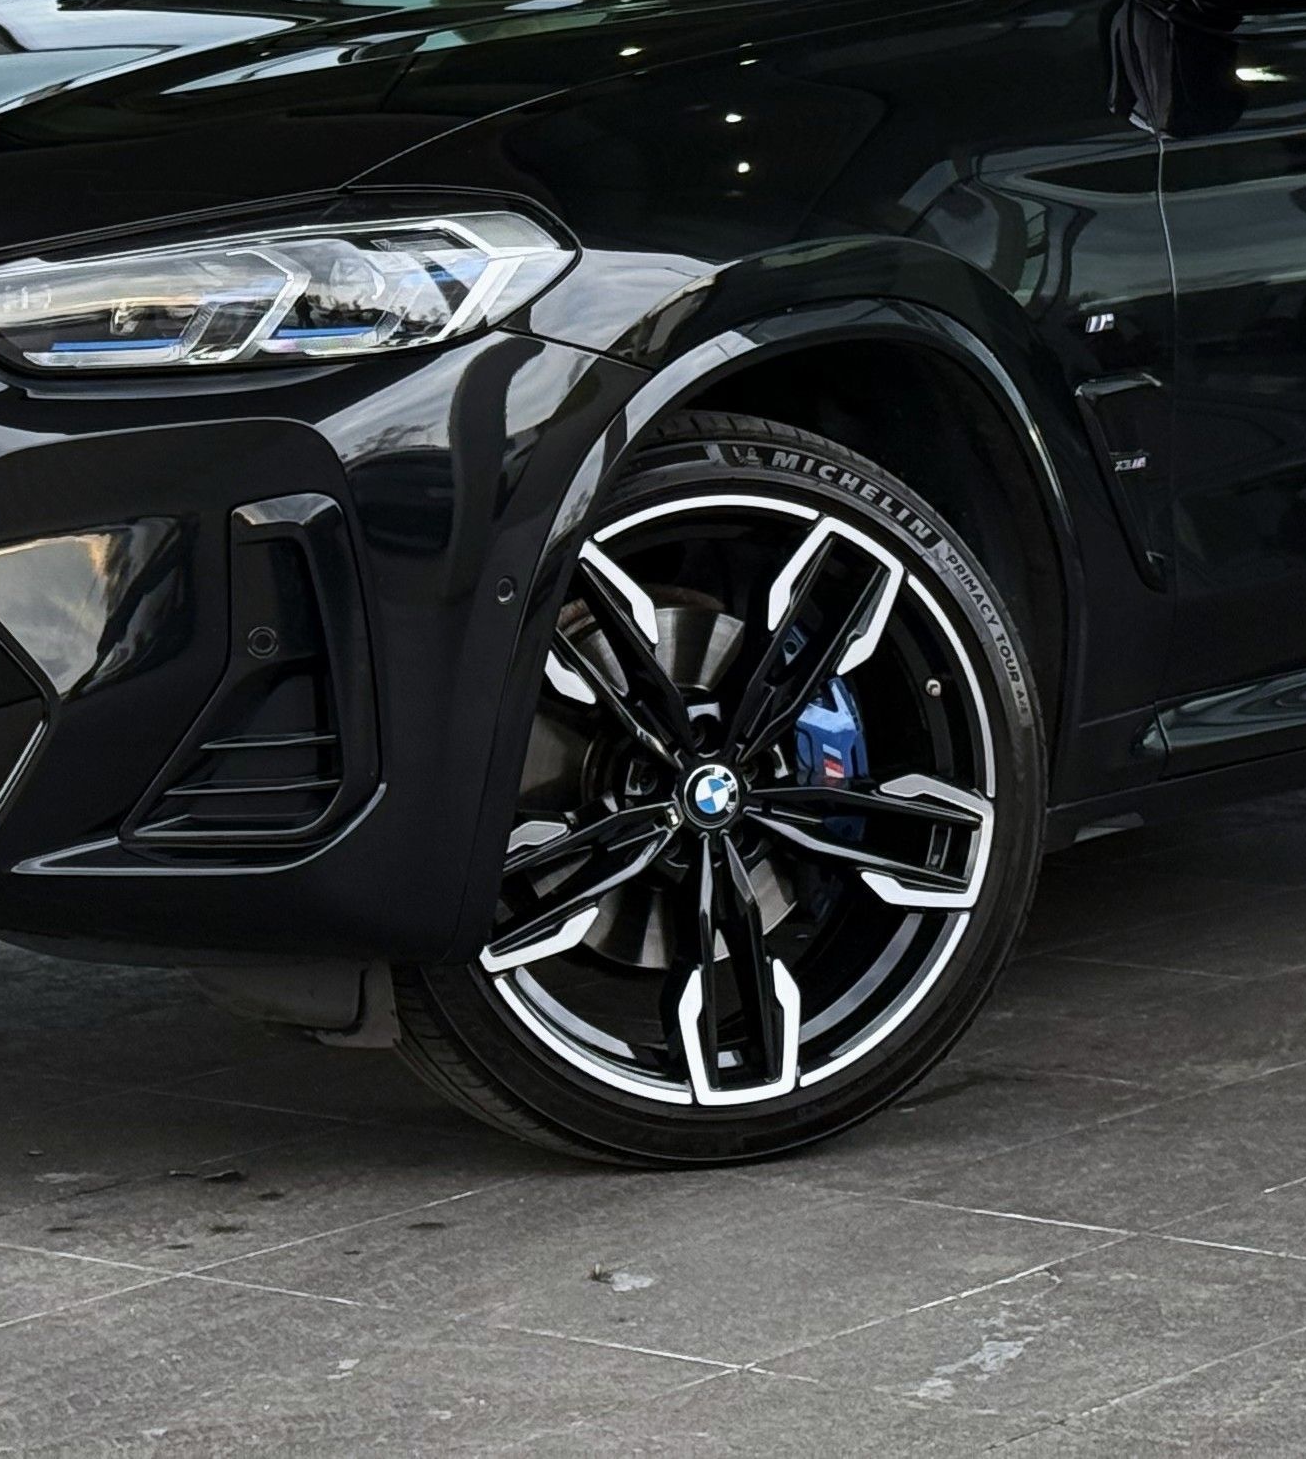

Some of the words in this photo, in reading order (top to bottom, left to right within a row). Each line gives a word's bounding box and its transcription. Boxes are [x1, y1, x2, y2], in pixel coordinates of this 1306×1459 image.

[771, 450, 932, 540] MICHELIN
[945, 553, 1000, 627] PRIMACY
[995, 633, 1021, 683] TOUR
